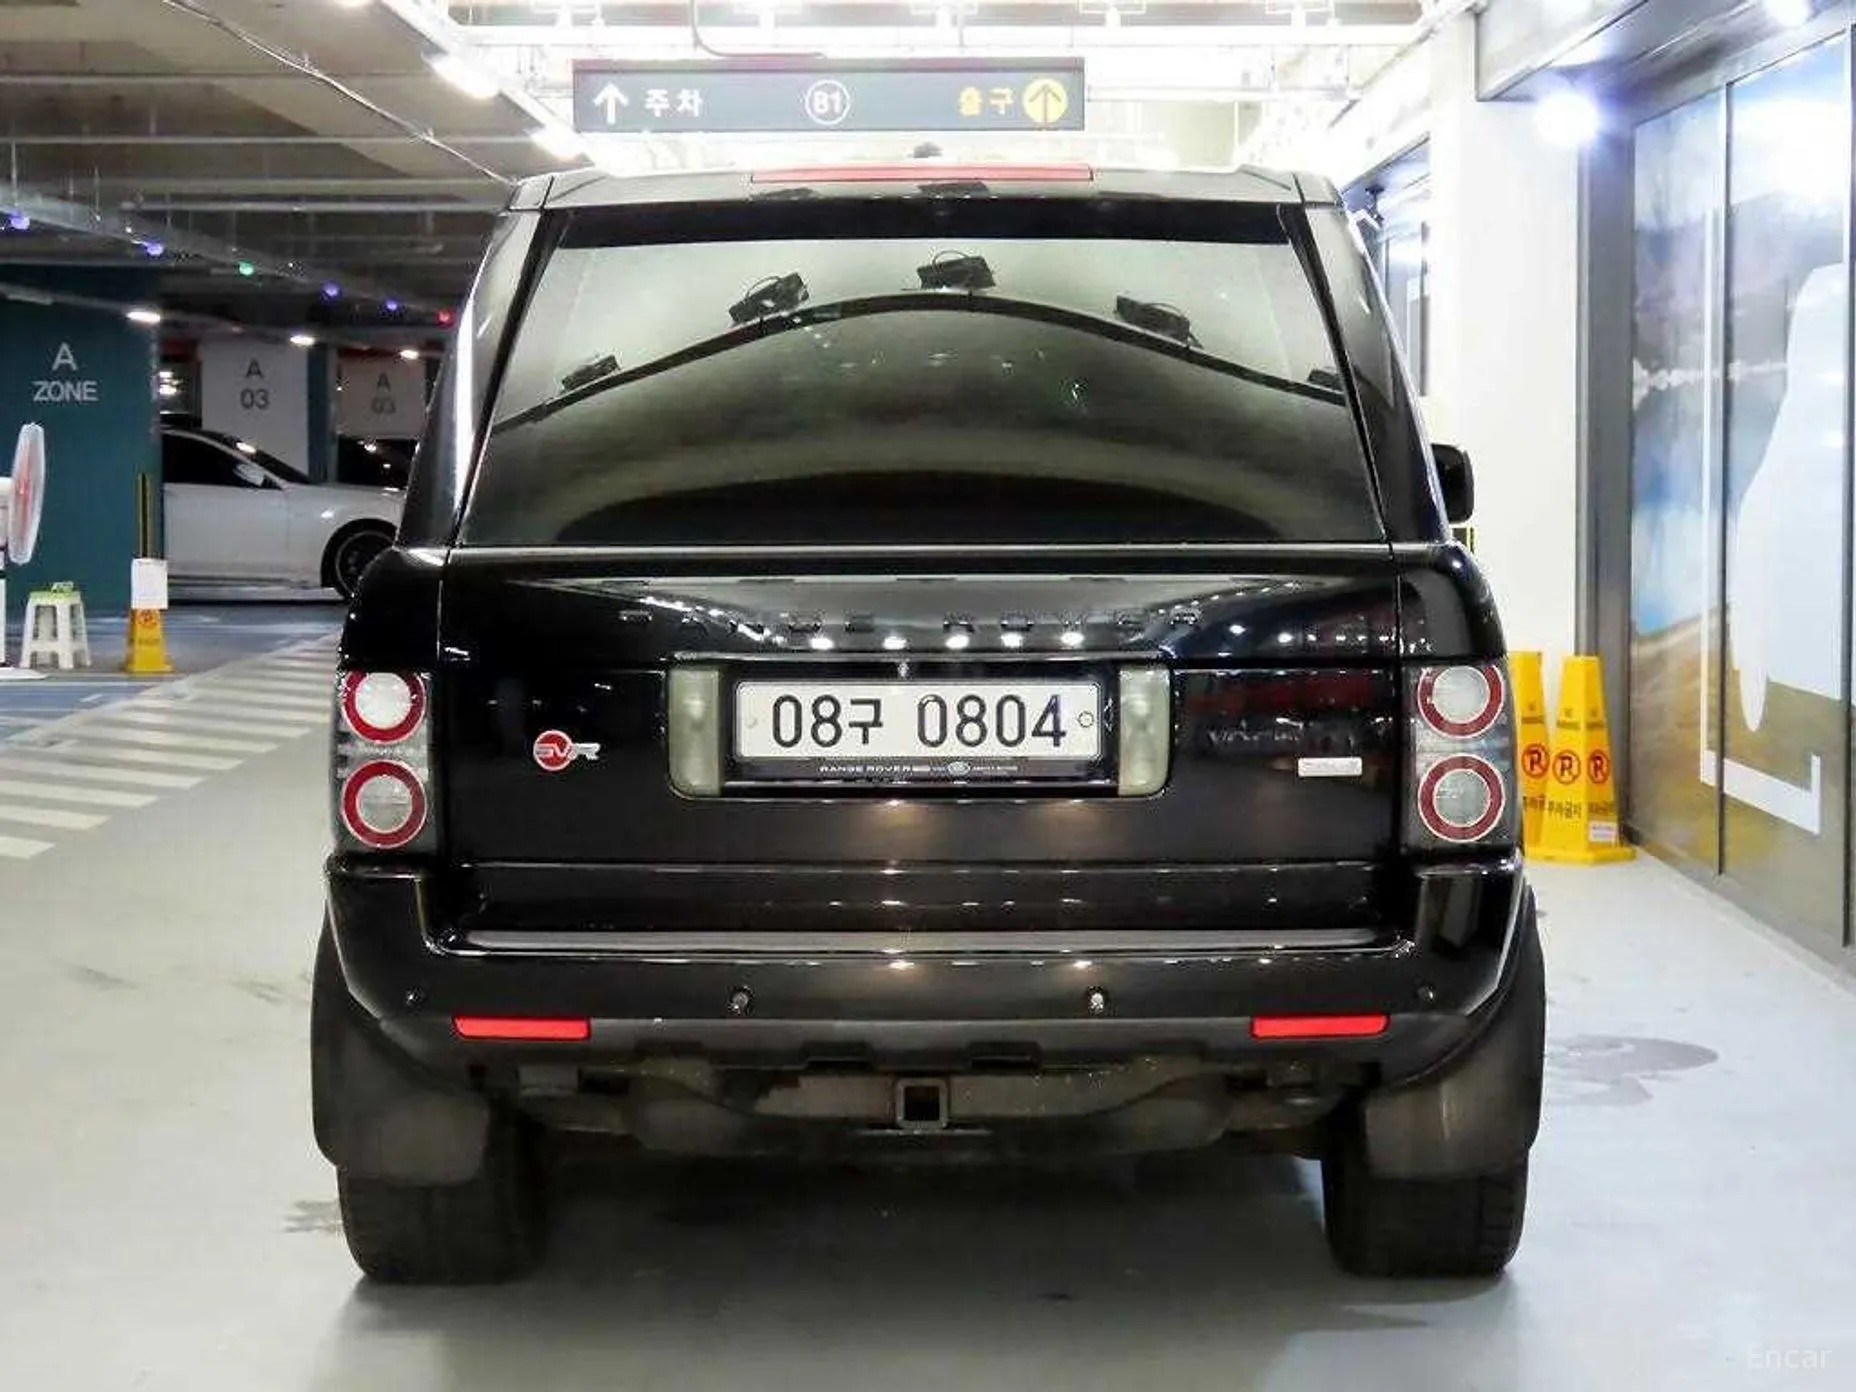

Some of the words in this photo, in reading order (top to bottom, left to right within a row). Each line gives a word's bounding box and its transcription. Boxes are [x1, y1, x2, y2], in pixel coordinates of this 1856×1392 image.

[644, 88, 703, 118] 주차
[52, 342, 78, 371] A
[245, 358, 264, 378] A
[31, 379, 99, 402] ZONE
[239, 388, 270, 409] 03
[771, 693, 884, 748] 08구
[916, 693, 1067, 749] 0804
